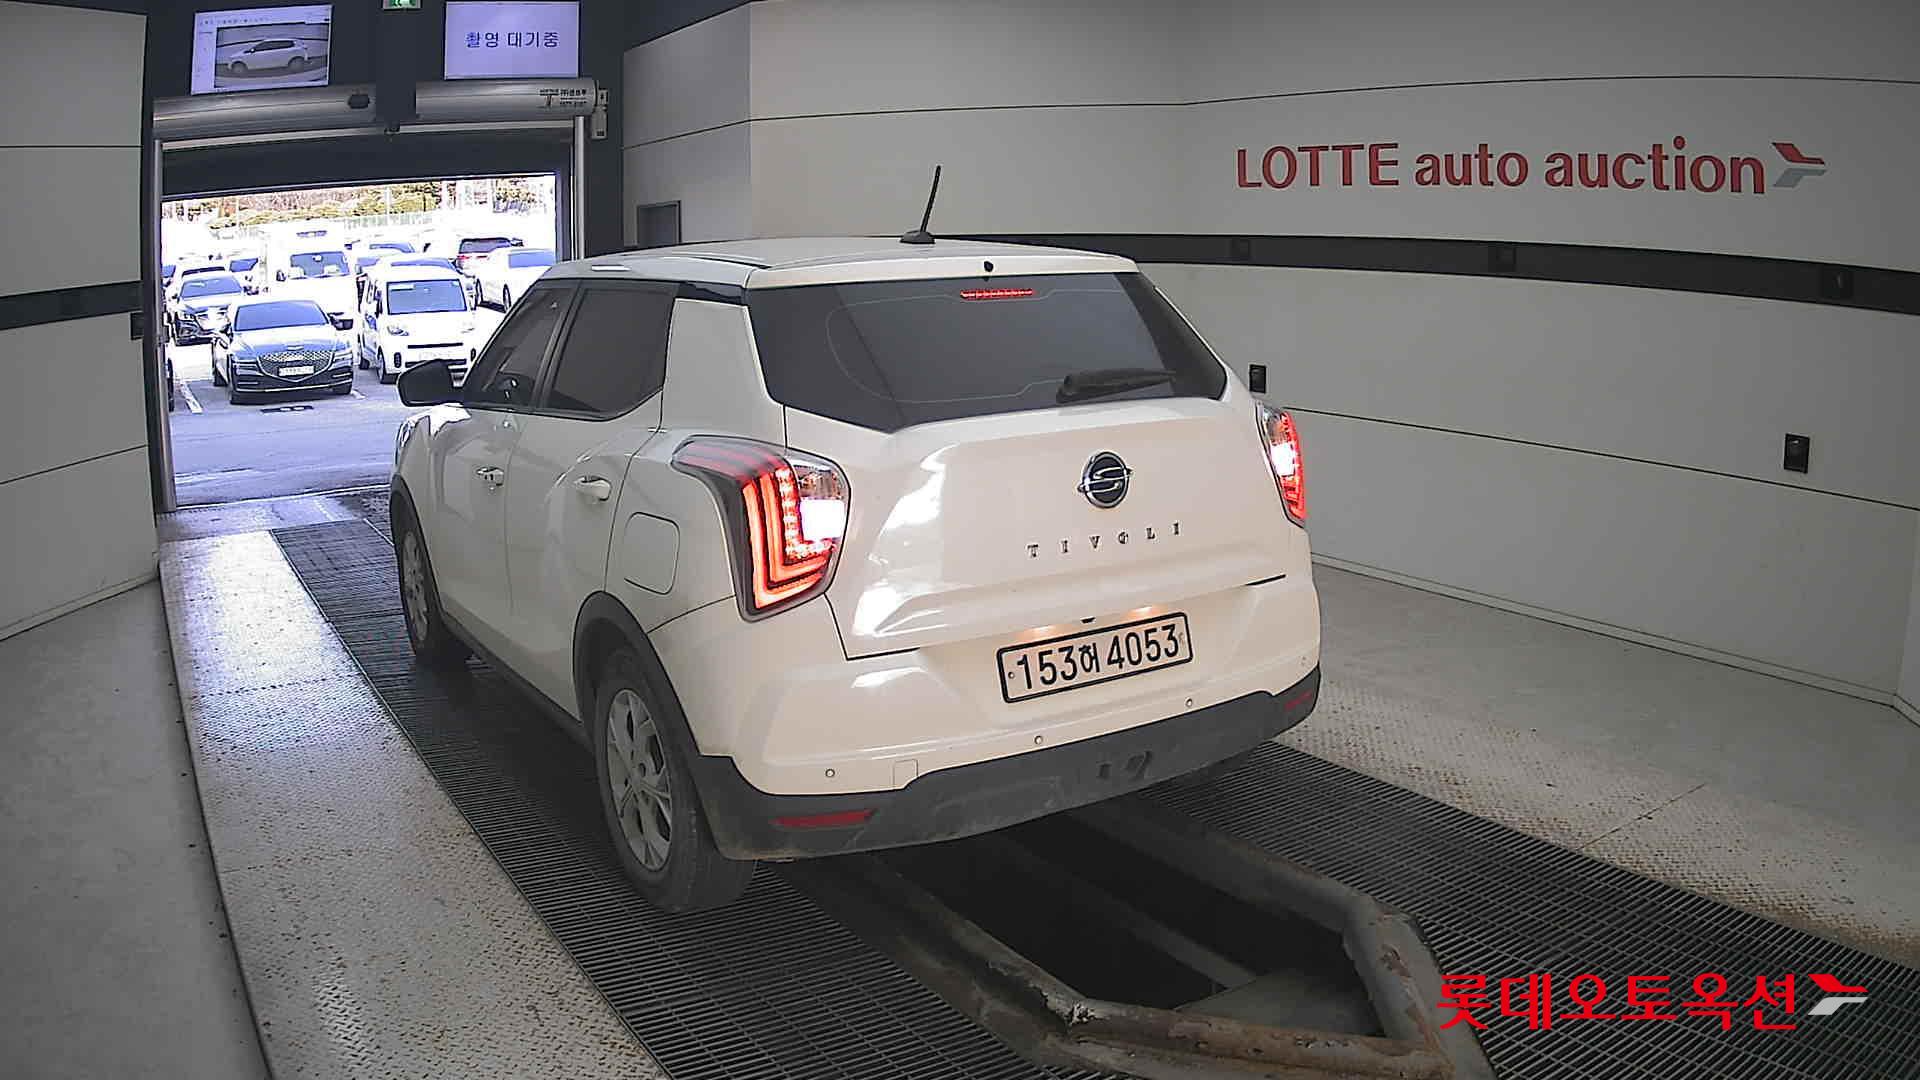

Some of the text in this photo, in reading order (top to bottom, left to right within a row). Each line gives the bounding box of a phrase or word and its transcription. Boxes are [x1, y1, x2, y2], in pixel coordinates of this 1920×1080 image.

[507, 31, 560, 48] 대기중
[1236, 136, 1765, 194] LOTTE auto auction
[1027, 521, 1181, 558] TIVOLI
[1016, 623, 1180, 690] 153허 4053
